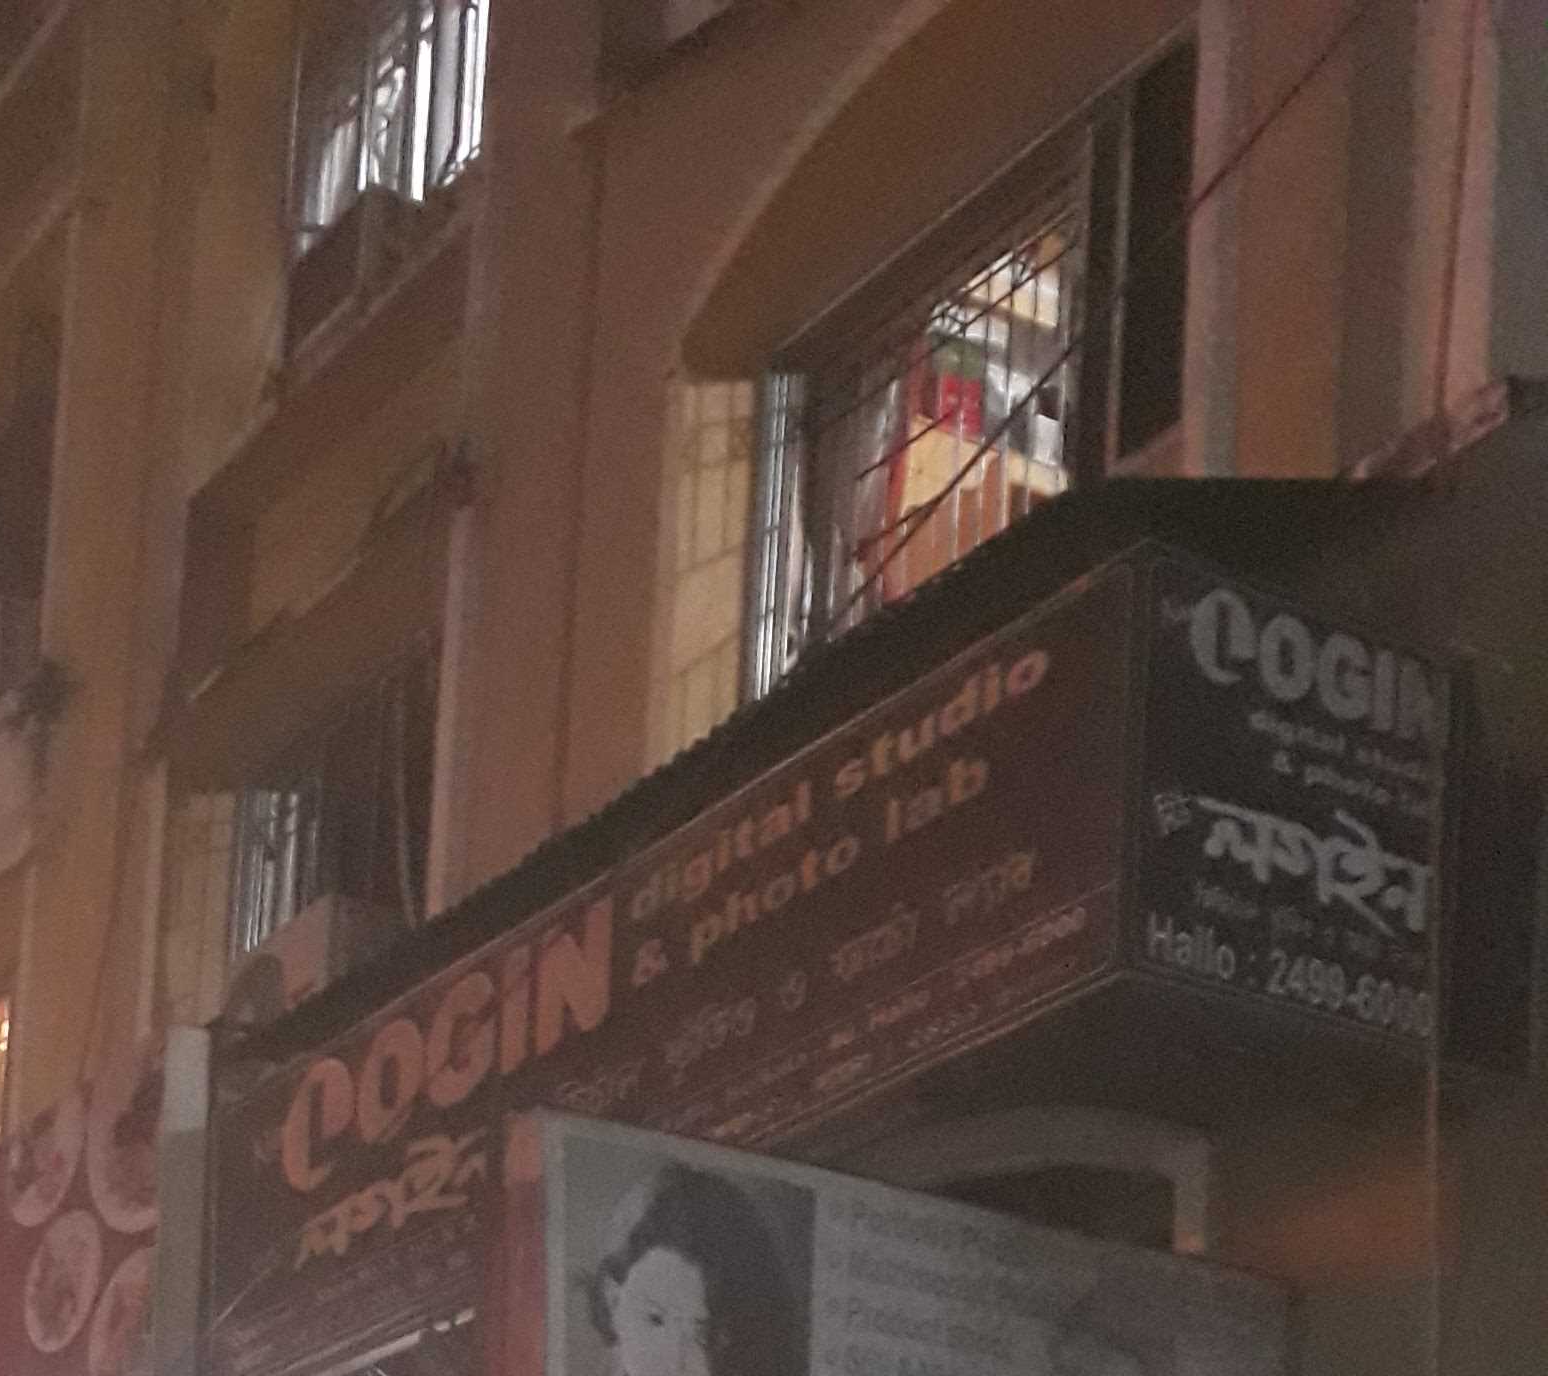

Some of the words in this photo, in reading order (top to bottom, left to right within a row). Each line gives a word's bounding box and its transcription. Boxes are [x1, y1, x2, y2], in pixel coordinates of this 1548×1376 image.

[632, 779, 812, 920] digital
[832, 648, 1051, 800] studio
[688, 834, 860, 965] photo
[884, 757, 990, 845] lab
[1147, 910, 1236, 980] Hallo
